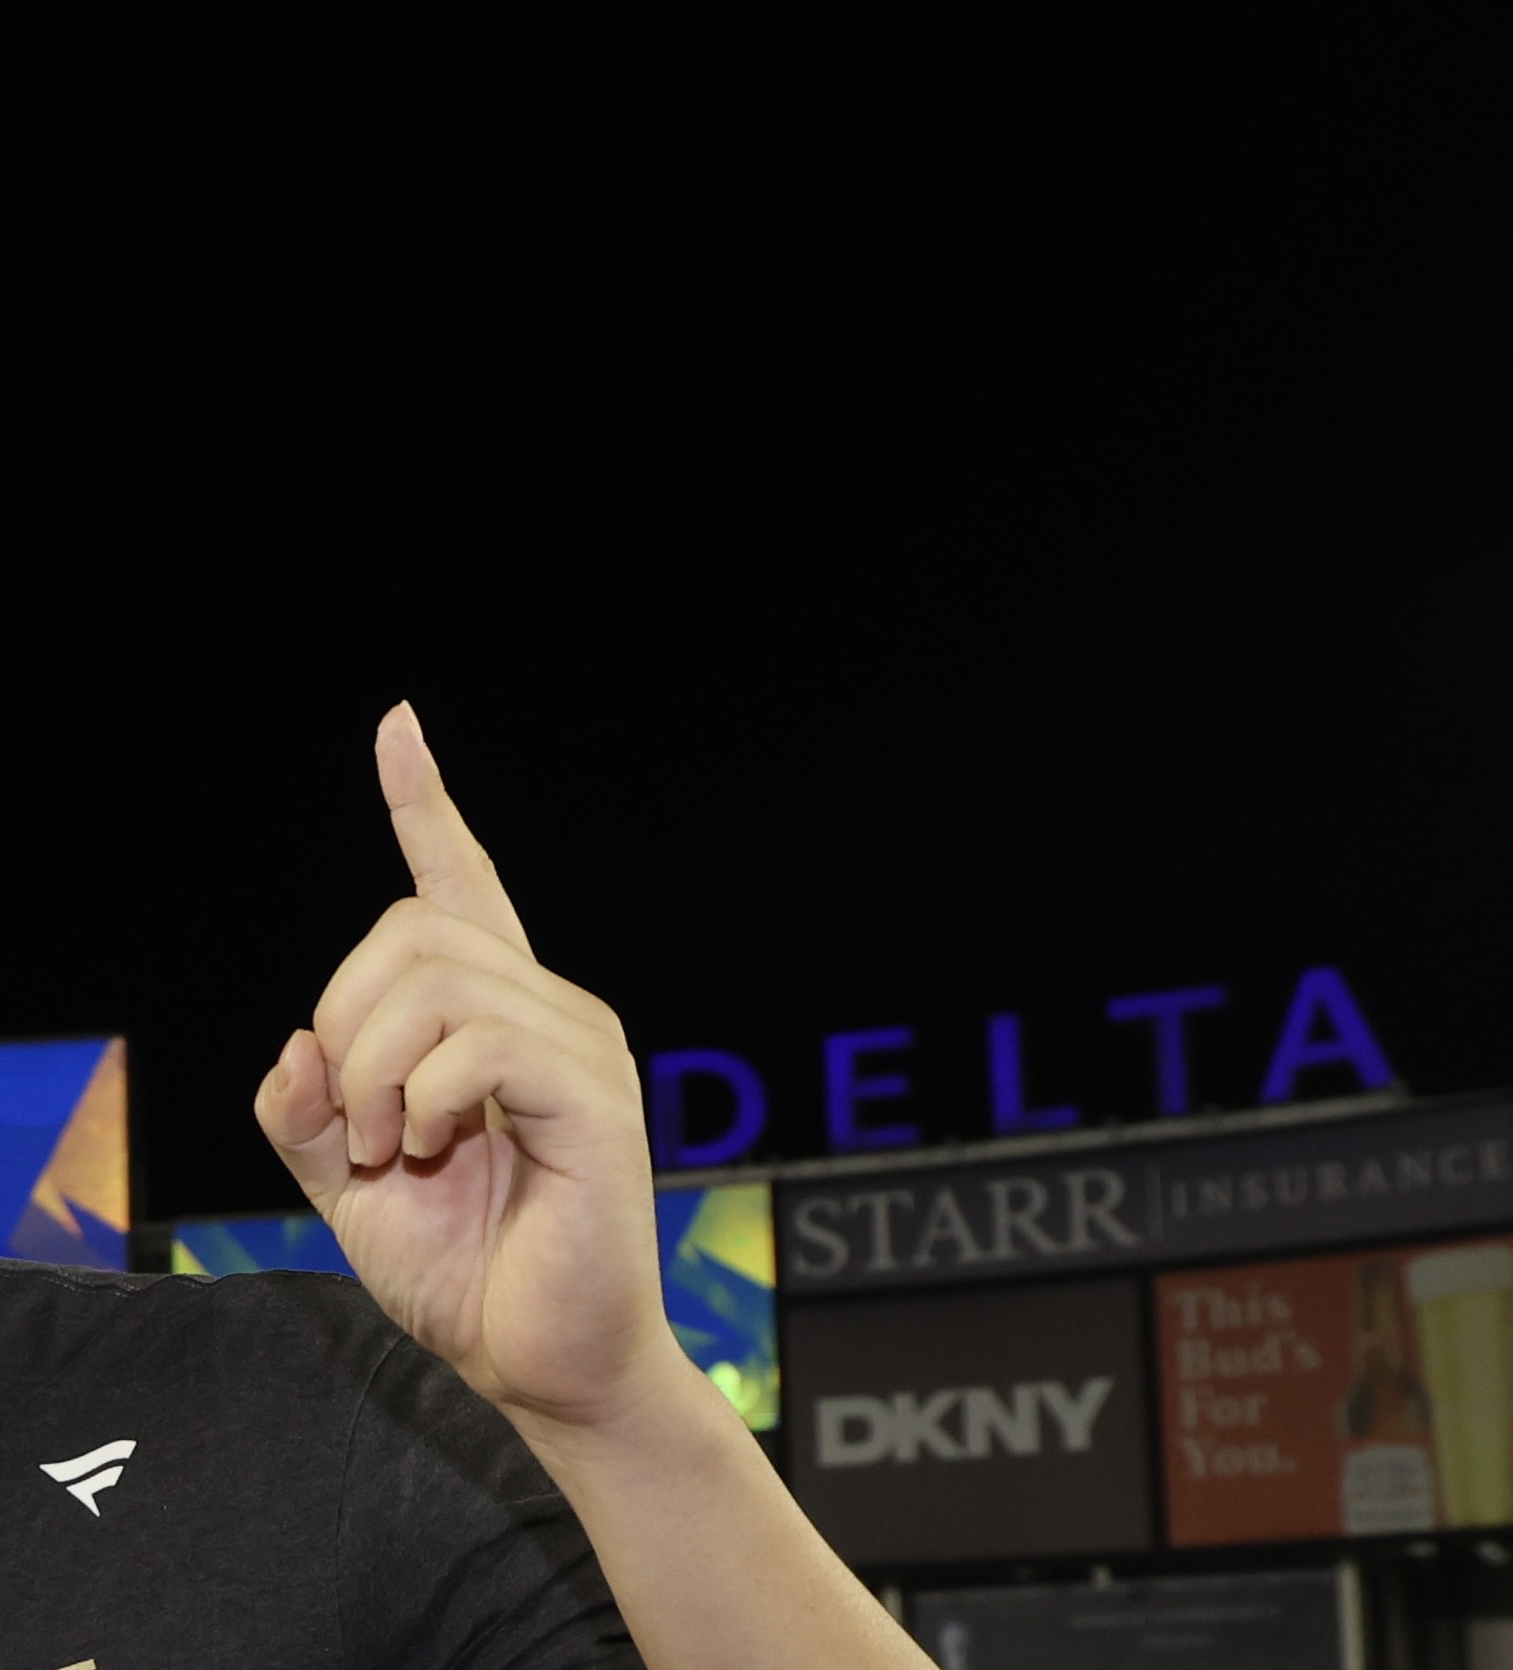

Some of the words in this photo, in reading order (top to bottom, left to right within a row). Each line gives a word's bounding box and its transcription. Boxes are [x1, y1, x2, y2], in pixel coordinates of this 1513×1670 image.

[650, 965, 1396, 1170] DELTA
[791, 1166, 1145, 1280] STARR
[1173, 1138, 1513, 1220] INSURANCE
[814, 1376, 1117, 1468] DKNY
